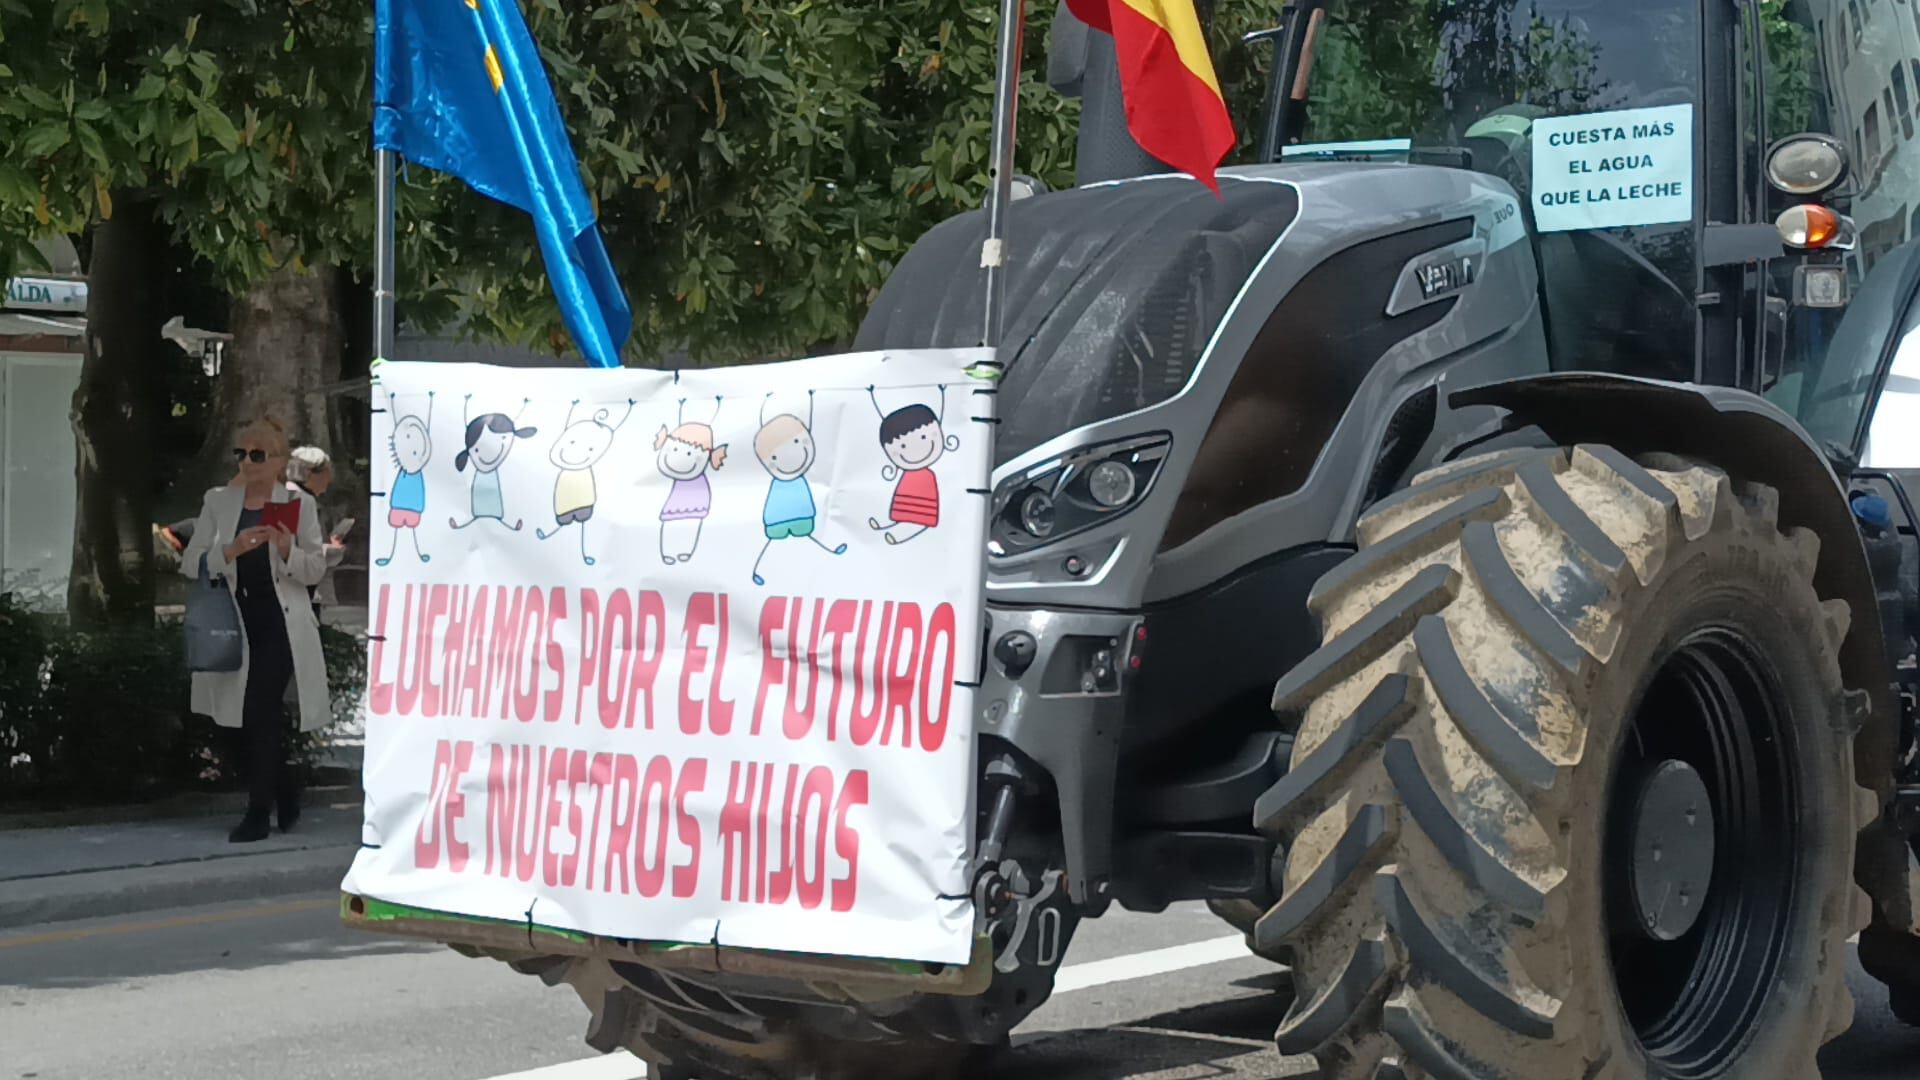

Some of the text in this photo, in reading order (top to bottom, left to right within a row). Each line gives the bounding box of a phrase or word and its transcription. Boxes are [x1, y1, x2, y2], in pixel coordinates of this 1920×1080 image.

[1548, 121, 1675, 147] CUESTA MÁS
[1568, 154, 1654, 174] EL AGUA
[1540, 182, 1682, 207] QUE LA LECHE
[369, 584, 956, 752] LUCHAMOS POR EL FUTURO
[414, 739, 870, 913] DE NUESTROS HIJOS
